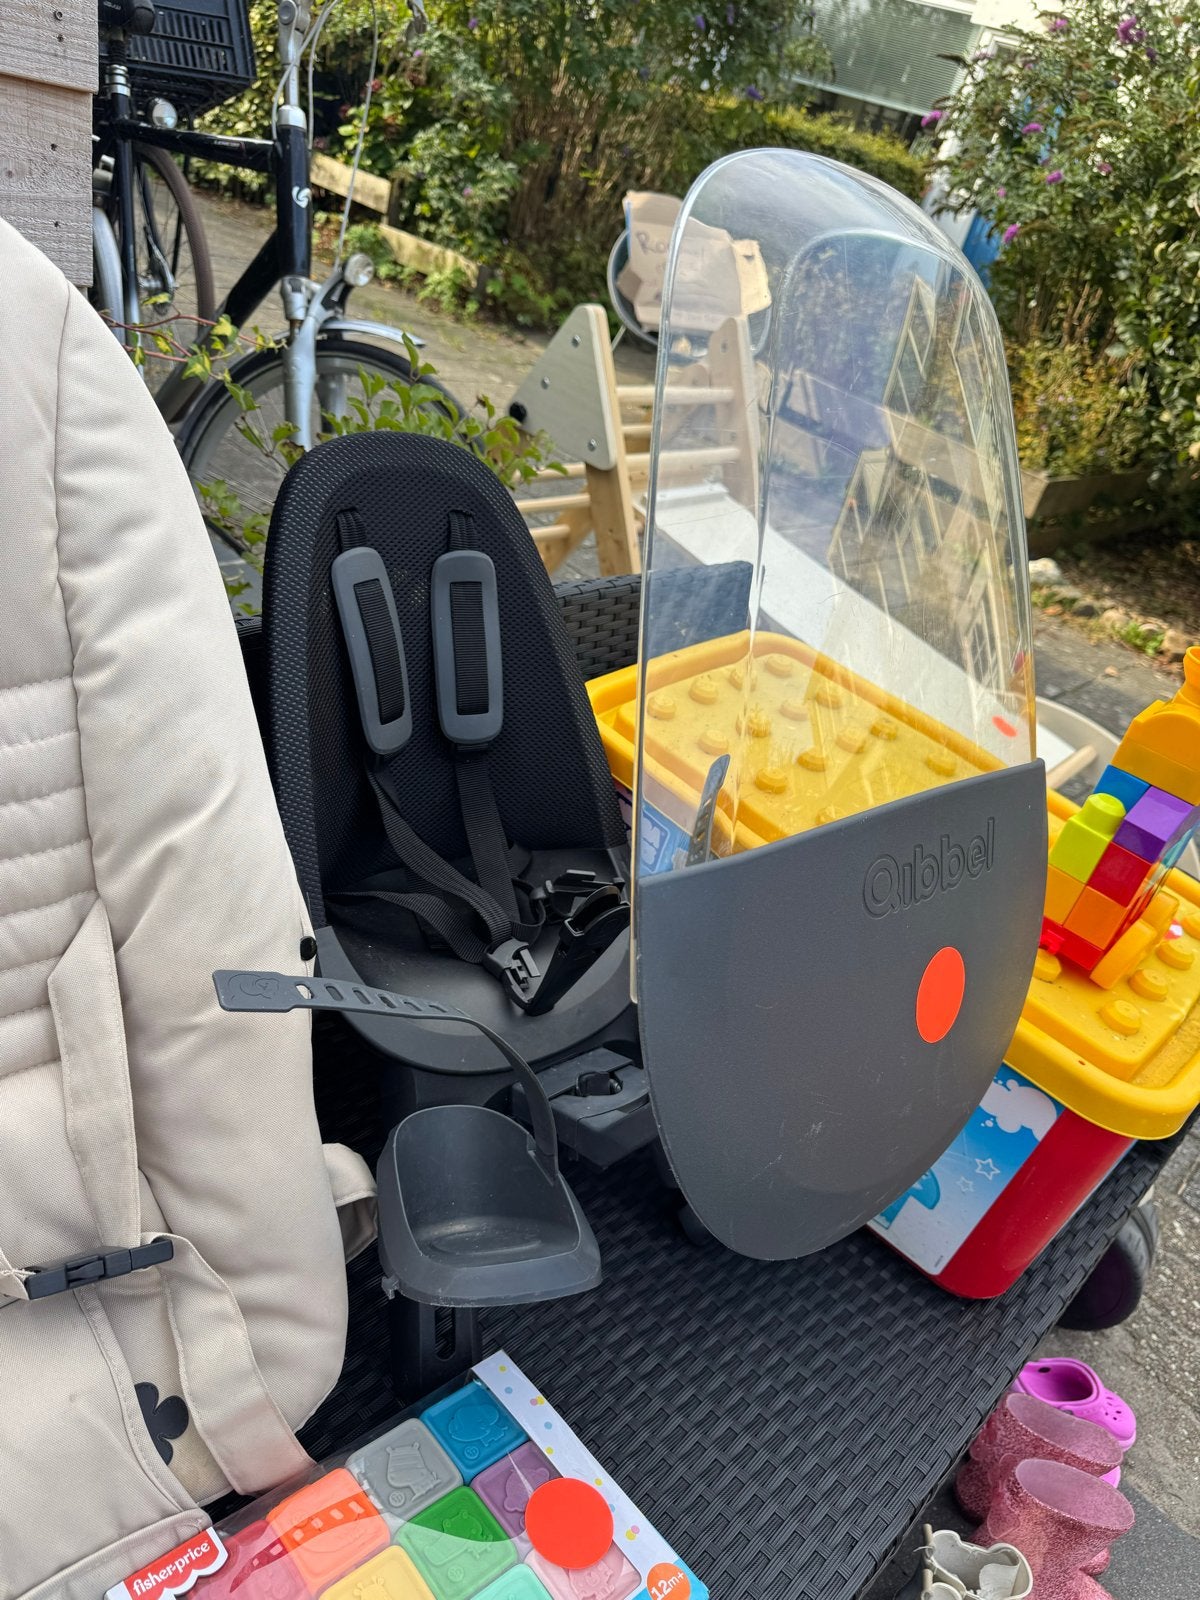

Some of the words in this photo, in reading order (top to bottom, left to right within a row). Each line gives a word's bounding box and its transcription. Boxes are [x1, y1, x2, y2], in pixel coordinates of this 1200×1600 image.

[863, 816, 995, 919] Qibbel
[133, 1542, 210, 1596] fisher-price
[651, 1571, 684, 1600] 12m+
